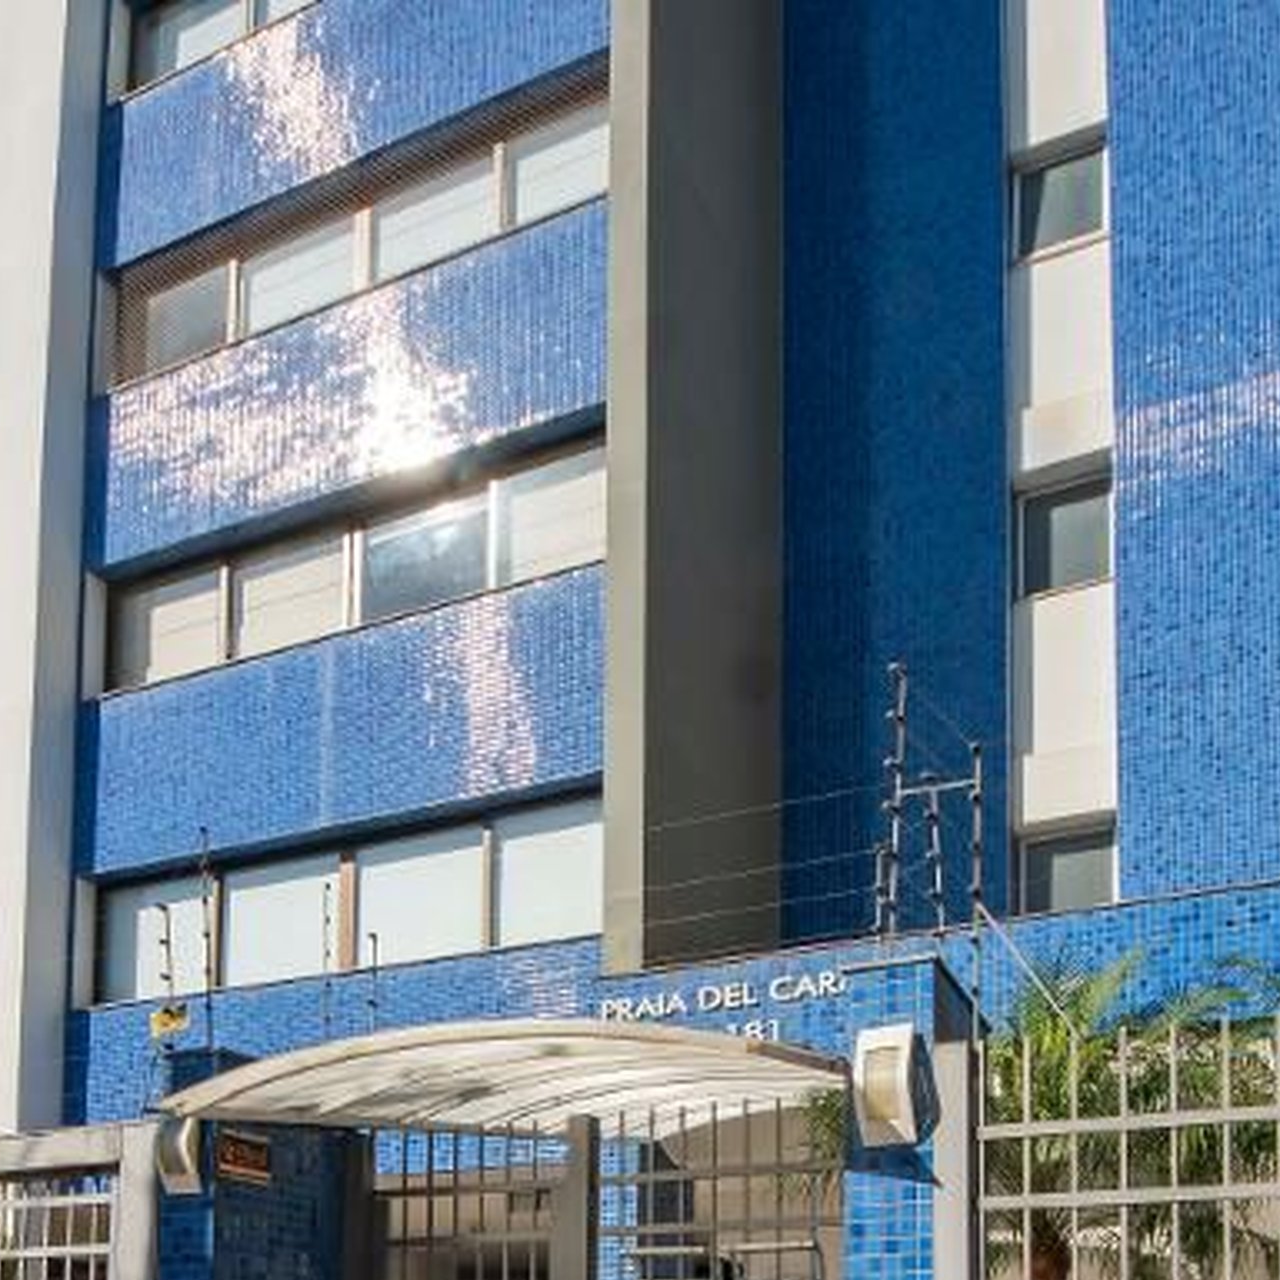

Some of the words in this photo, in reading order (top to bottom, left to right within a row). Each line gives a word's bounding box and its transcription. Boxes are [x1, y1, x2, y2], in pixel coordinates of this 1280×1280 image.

[601, 991, 687, 1021] PRAIA
[698, 982, 758, 1011] DEL
[769, 970, 848, 1001] CAR
